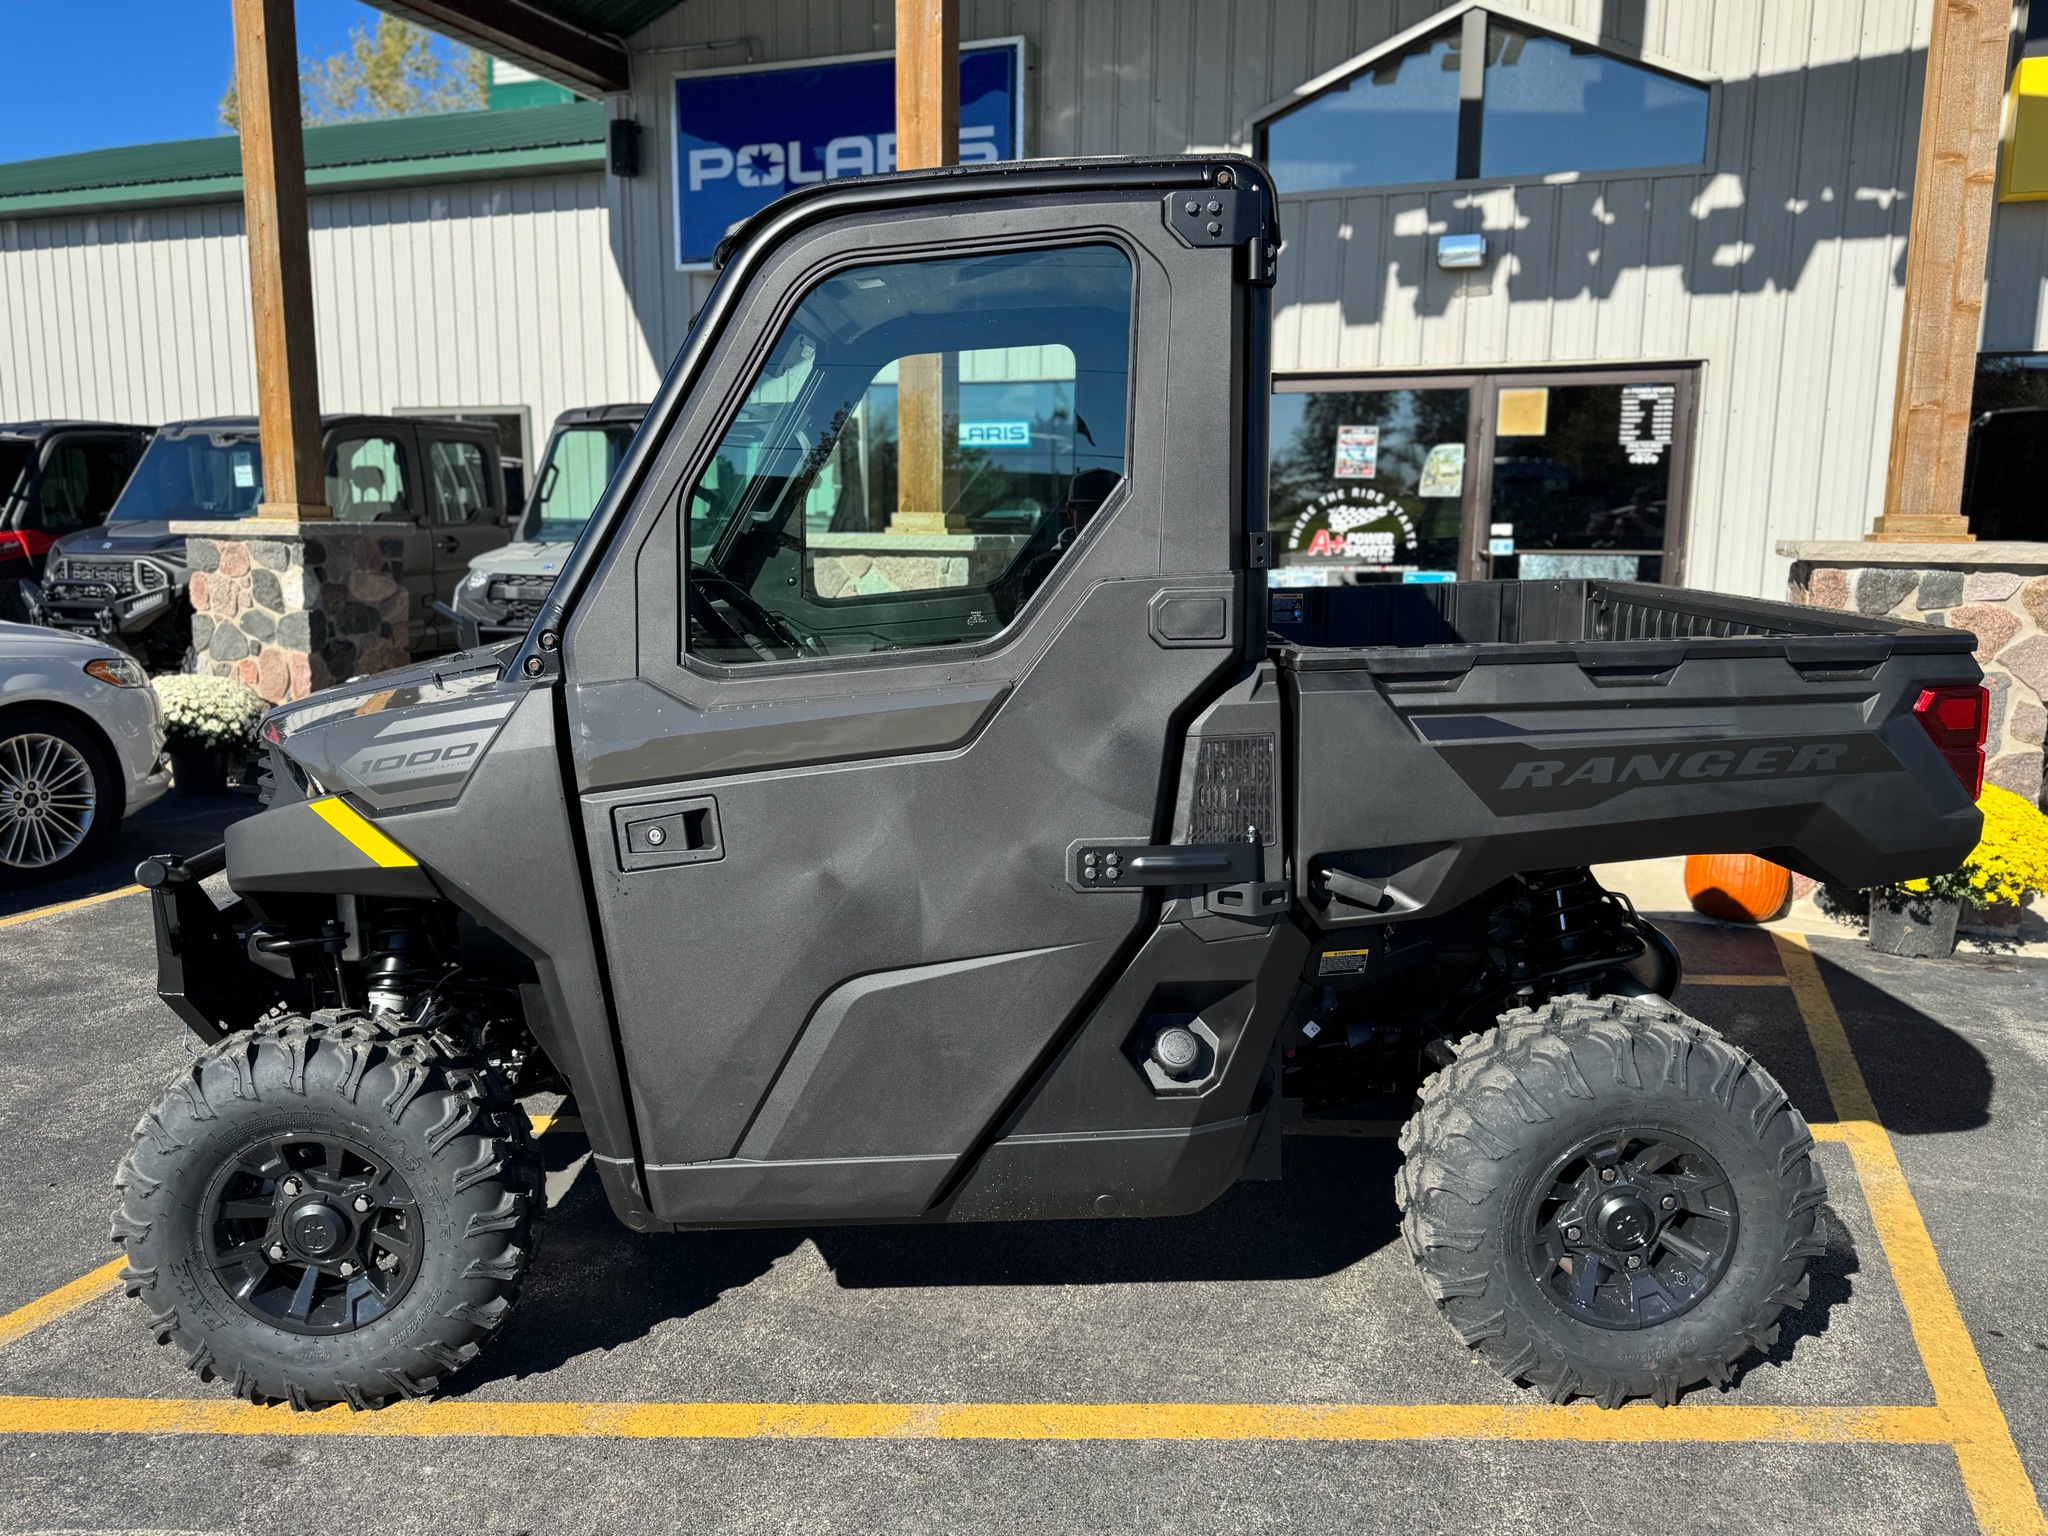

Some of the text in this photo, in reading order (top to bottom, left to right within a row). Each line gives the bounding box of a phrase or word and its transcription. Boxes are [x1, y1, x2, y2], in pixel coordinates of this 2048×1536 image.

[689, 124, 999, 192] POLAS
[959, 426, 1025, 441] ARIS
[1288, 487, 1418, 550] WHERE THE RIDE STARTS
[1307, 529, 1395, 557] A+ POWER
[1344, 544, 1395, 557] SPORTS
[73, 569, 133, 583] POLARIS
[359, 742, 479, 775] 1000
[1500, 743, 1850, 790] RANGER
